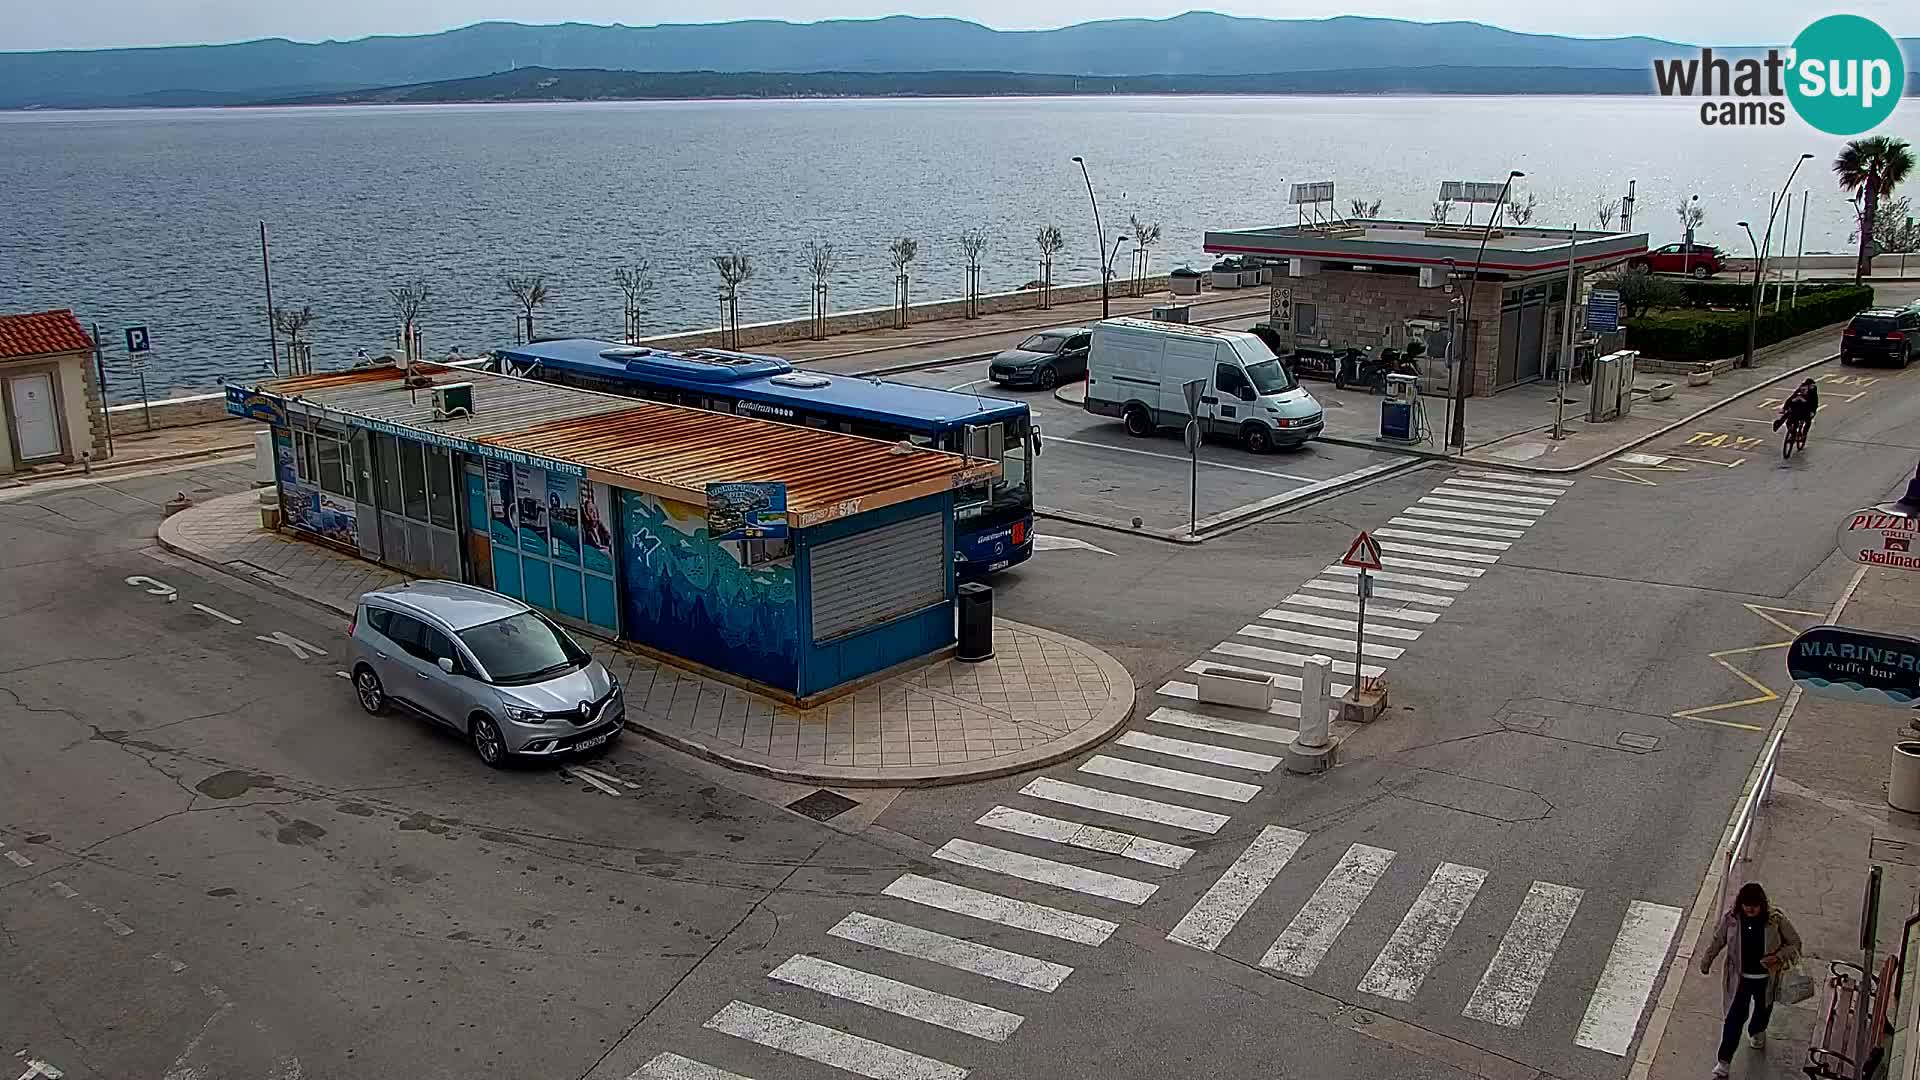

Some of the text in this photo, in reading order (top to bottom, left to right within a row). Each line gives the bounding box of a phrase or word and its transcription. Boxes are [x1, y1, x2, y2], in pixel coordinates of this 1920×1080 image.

[131, 330, 143, 349] P
[1685, 431, 1764, 449] TAXI
[479, 445, 494, 457] BUS
[494, 449, 527, 464] STATION
[528, 456, 555, 470] TICKET
[556, 463, 583, 476] OFFICE
[1848, 514, 1920, 532] PIZZE
[1881, 529, 1916, 541] GRILL
[1870, 665, 1896, 680] bar
